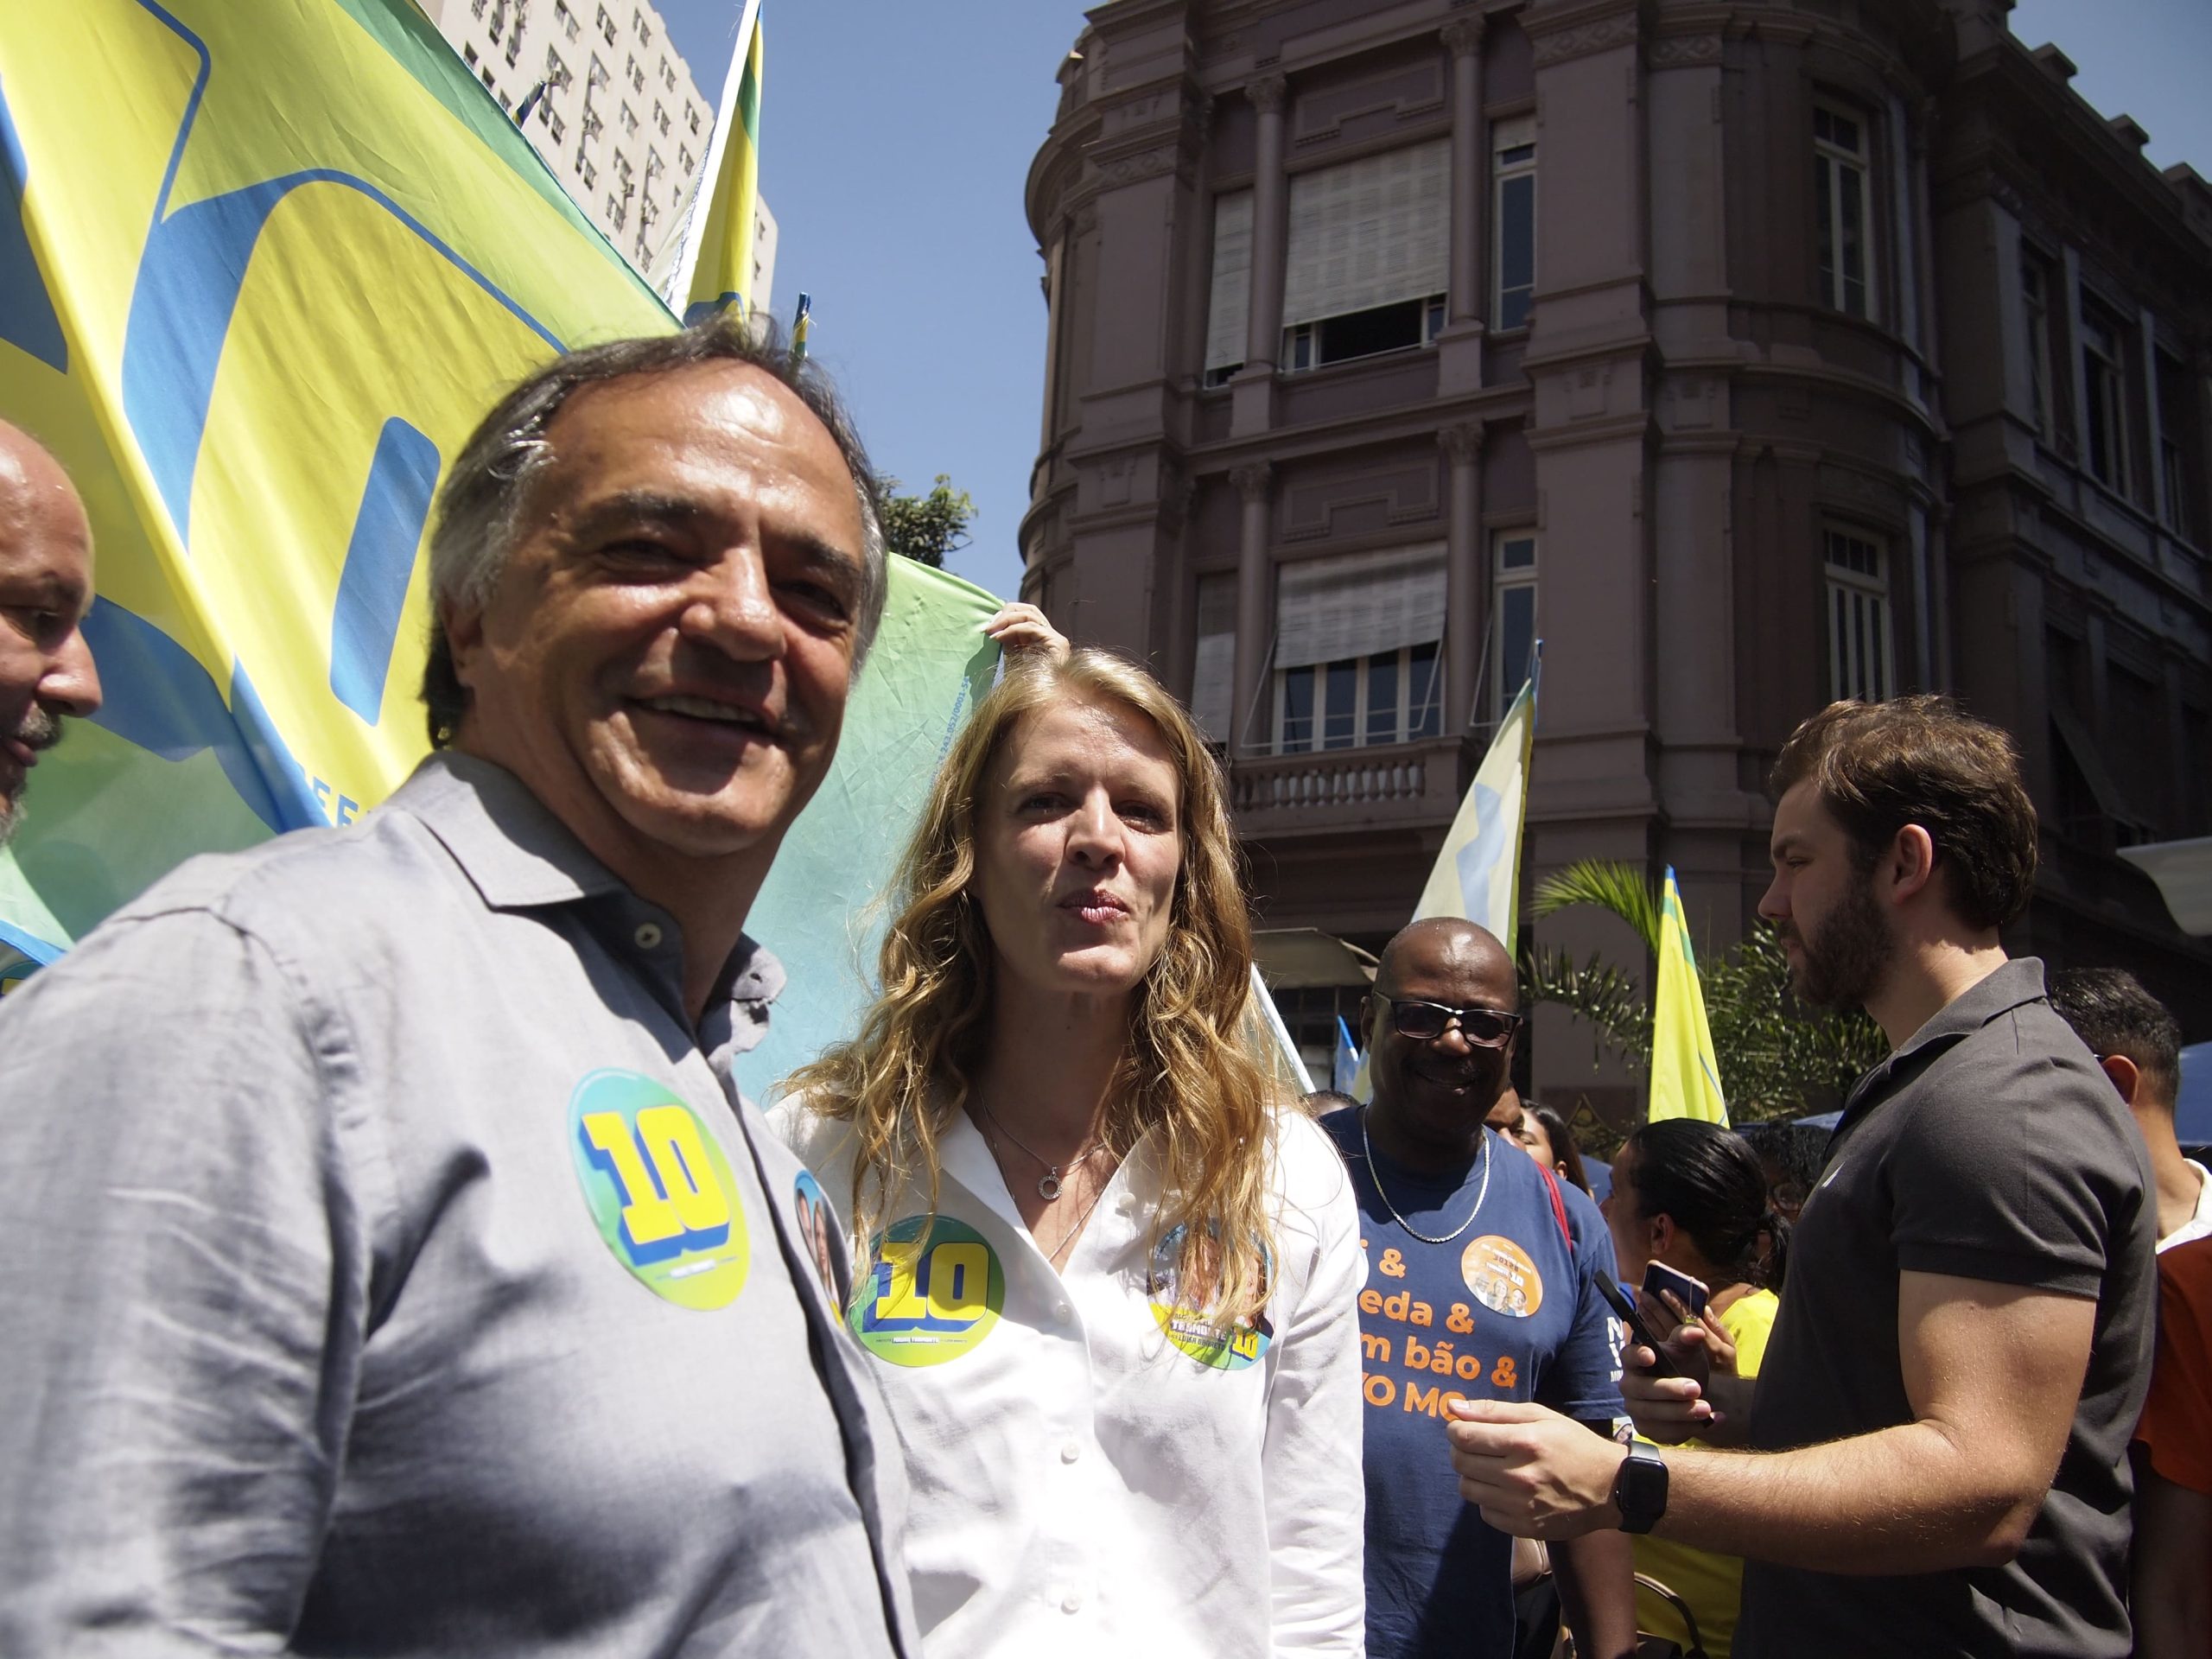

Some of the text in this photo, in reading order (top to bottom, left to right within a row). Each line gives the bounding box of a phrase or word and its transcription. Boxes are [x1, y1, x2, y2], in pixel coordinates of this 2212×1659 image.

[580, 1105, 729, 1255] 10
[871, 1242, 990, 1325] 10
[1379, 1249, 1406, 1278] &
[1359, 1290, 1475, 1334] eda &
[1230, 1326, 1258, 1361] 10
[1404, 1335, 1480, 1380] bão
[1491, 1356, 1517, 1389] &
